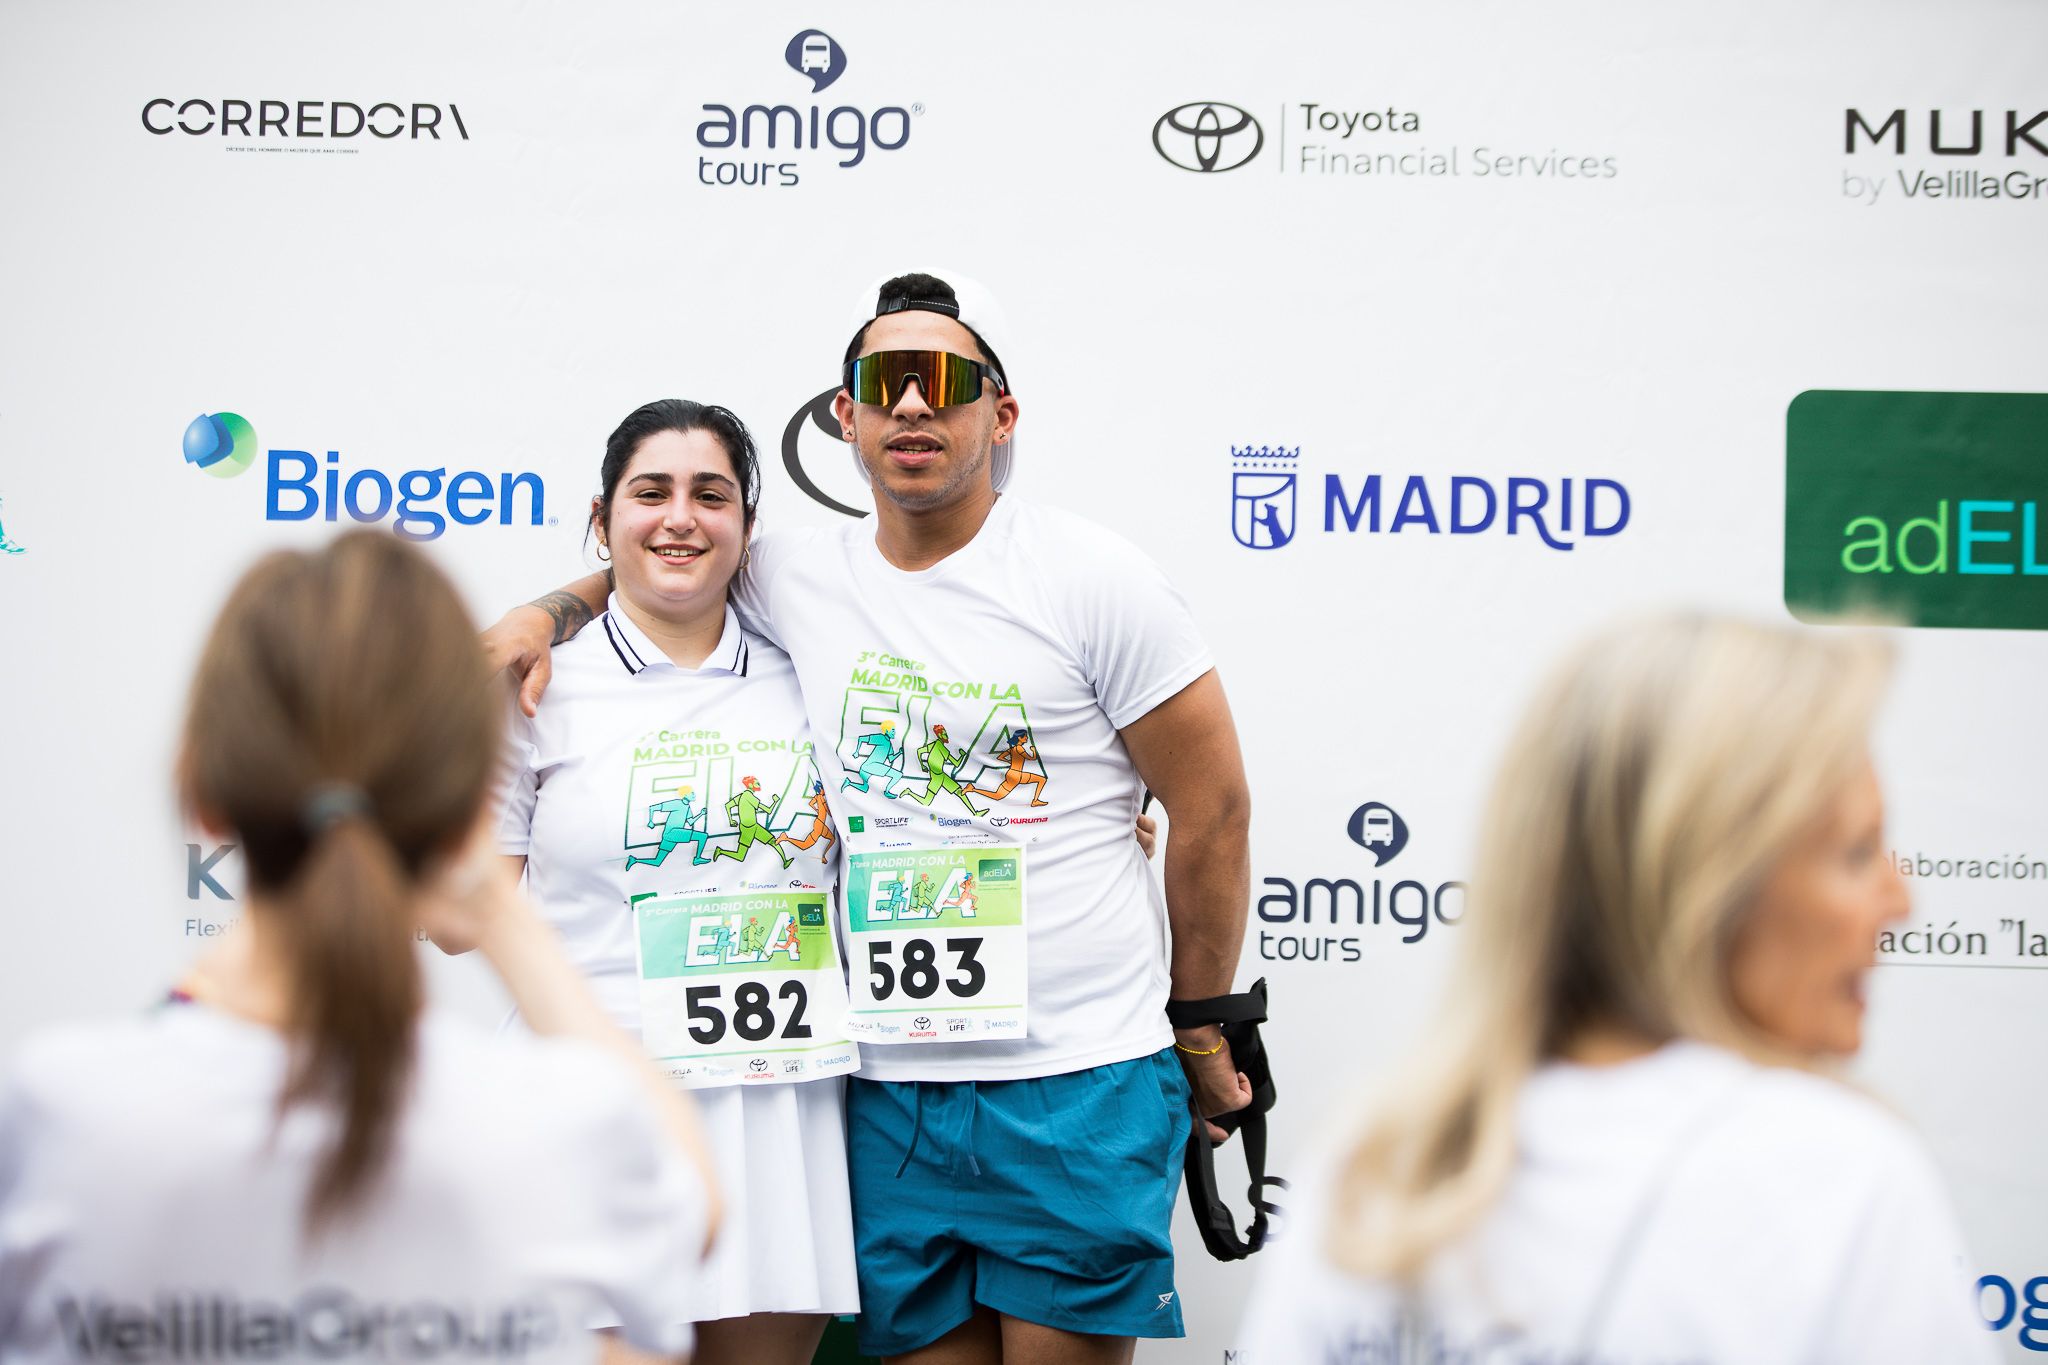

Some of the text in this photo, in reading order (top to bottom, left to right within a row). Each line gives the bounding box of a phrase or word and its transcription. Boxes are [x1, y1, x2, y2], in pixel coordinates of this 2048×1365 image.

[696, 104, 909, 168] amigo
[1300, 104, 1420, 139] Toyota
[699, 156, 799, 186] tours
[1301, 145, 1617, 178] Financial Services
[1843, 168, 2048, 206] by VelillaGr
[266, 450, 545, 542] Biogen
[1323, 474, 1632, 551] MADRID
[850, 668, 1022, 700] MADRID CON LA
[633, 739, 814, 762] MADRID CON LA
[658, 729, 721, 742] Carrera
[836, 688, 1048, 783] ELA
[938, 816, 972, 828] Biogen
[872, 856, 915, 869] MADRID
[918, 856, 946, 867] CON
[949, 855, 966, 865] LA
[984, 869, 1011, 877] adELA
[1888, 847, 2048, 879] laboración
[691, 902, 743, 914] MADRID
[746, 900, 773, 911] CON
[775, 899, 788, 909] LA
[867, 867, 976, 922] ELA
[1257, 877, 1467, 943] amigo
[185, 918, 240, 937] Flexi
[684, 912, 800, 967] ELA
[1878, 919, 1988, 956] ación
[1260, 930, 1361, 962] tours
[868, 937, 986, 1002] 583
[685, 979, 812, 1045] 582
[785, 1065, 799, 1073] LIFE
[823, 1055, 851, 1066] MADRID
